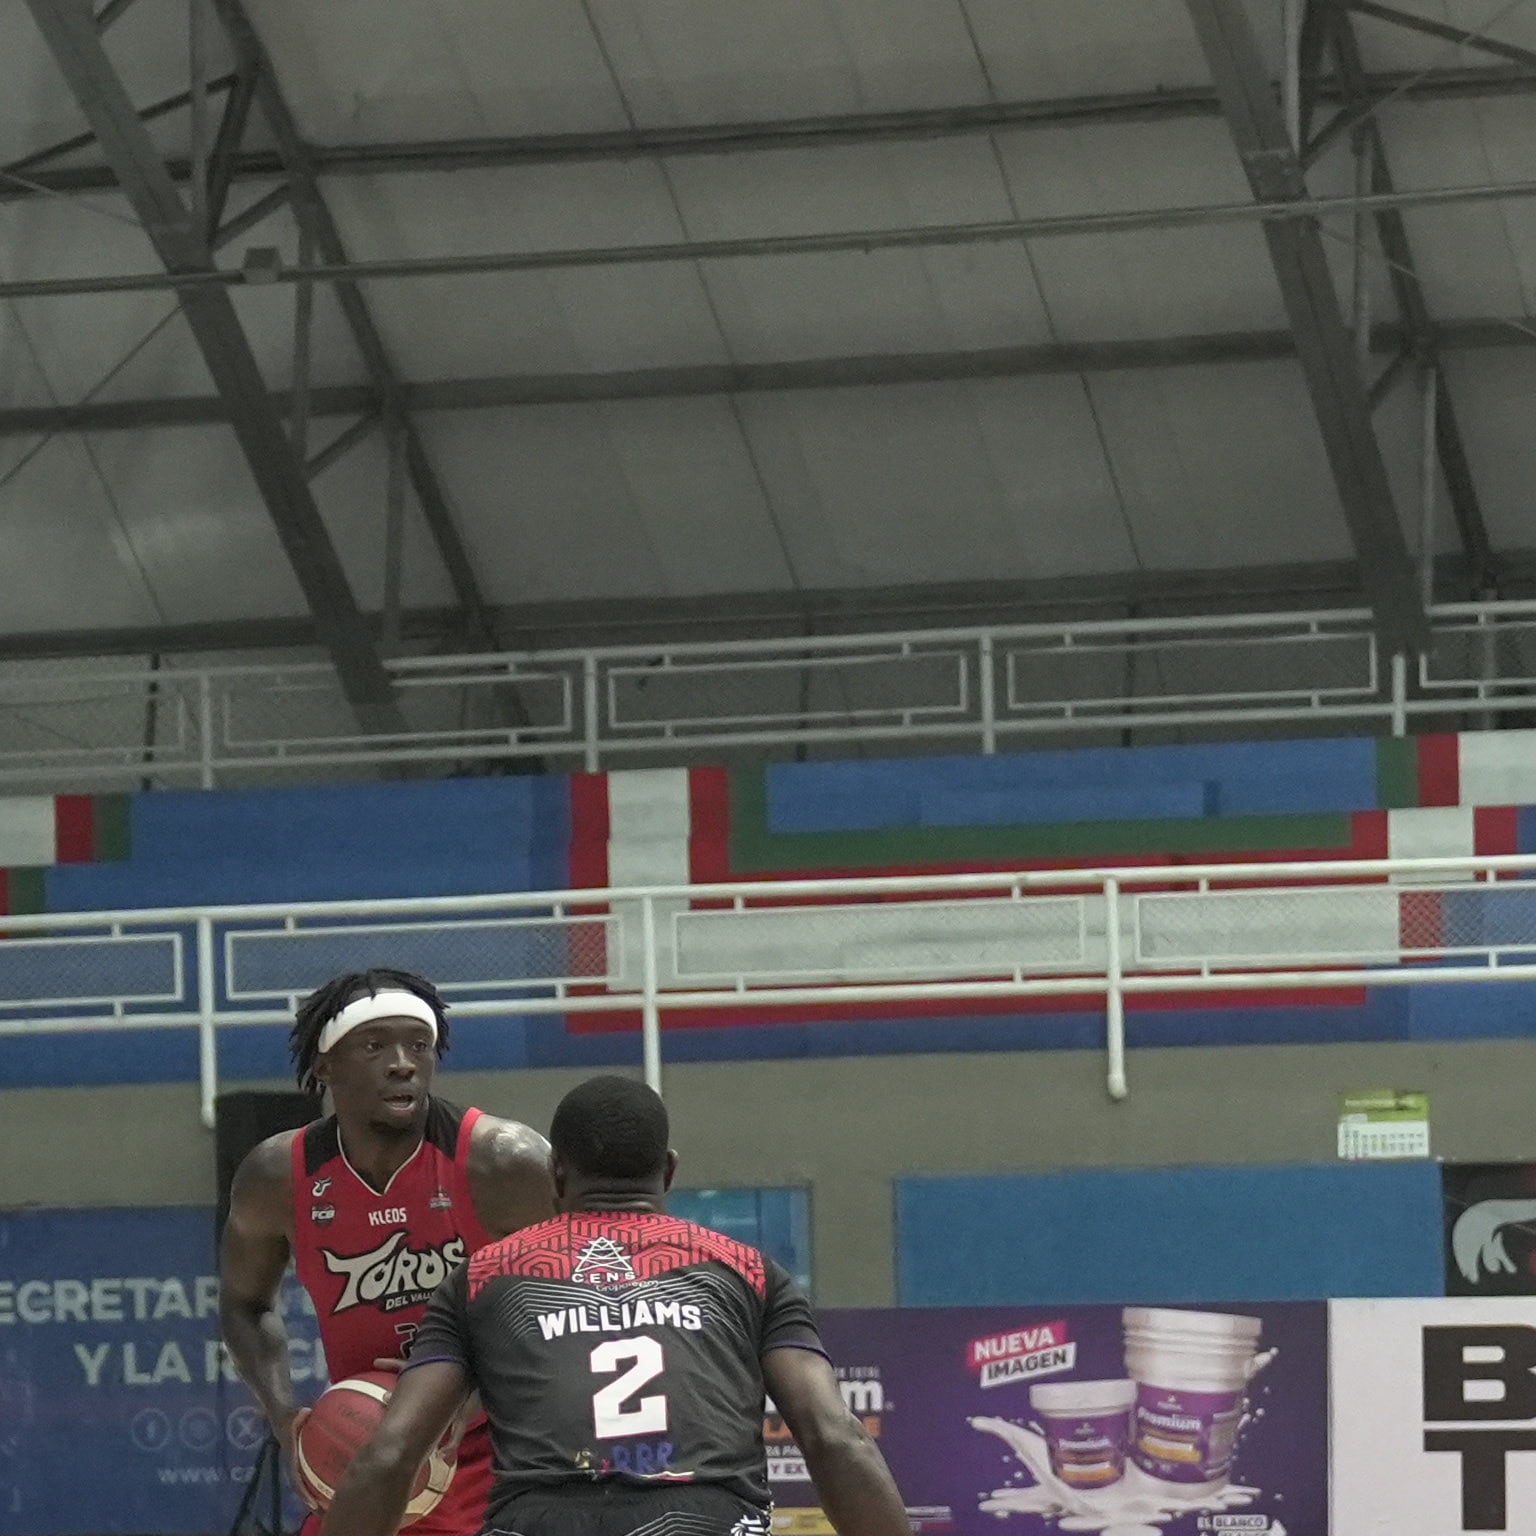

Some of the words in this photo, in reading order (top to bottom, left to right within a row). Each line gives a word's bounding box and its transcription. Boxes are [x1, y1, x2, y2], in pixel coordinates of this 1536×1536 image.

[368, 1207, 408, 1226] KLEOS
[571, 1271, 636, 1283] CENS
[385, 1296, 409, 1311] DEL
[410, 1291, 435, 1304] VALL
[537, 1299, 703, 1341] WILLIAMS
[973, 1326, 1055, 1362] NUEVA
[74, 1343, 110, 1385] Y
[123, 1341, 192, 1384] LA
[987, 1349, 1068, 1380] IMAGEN
[590, 1335, 668, 1439] 2
